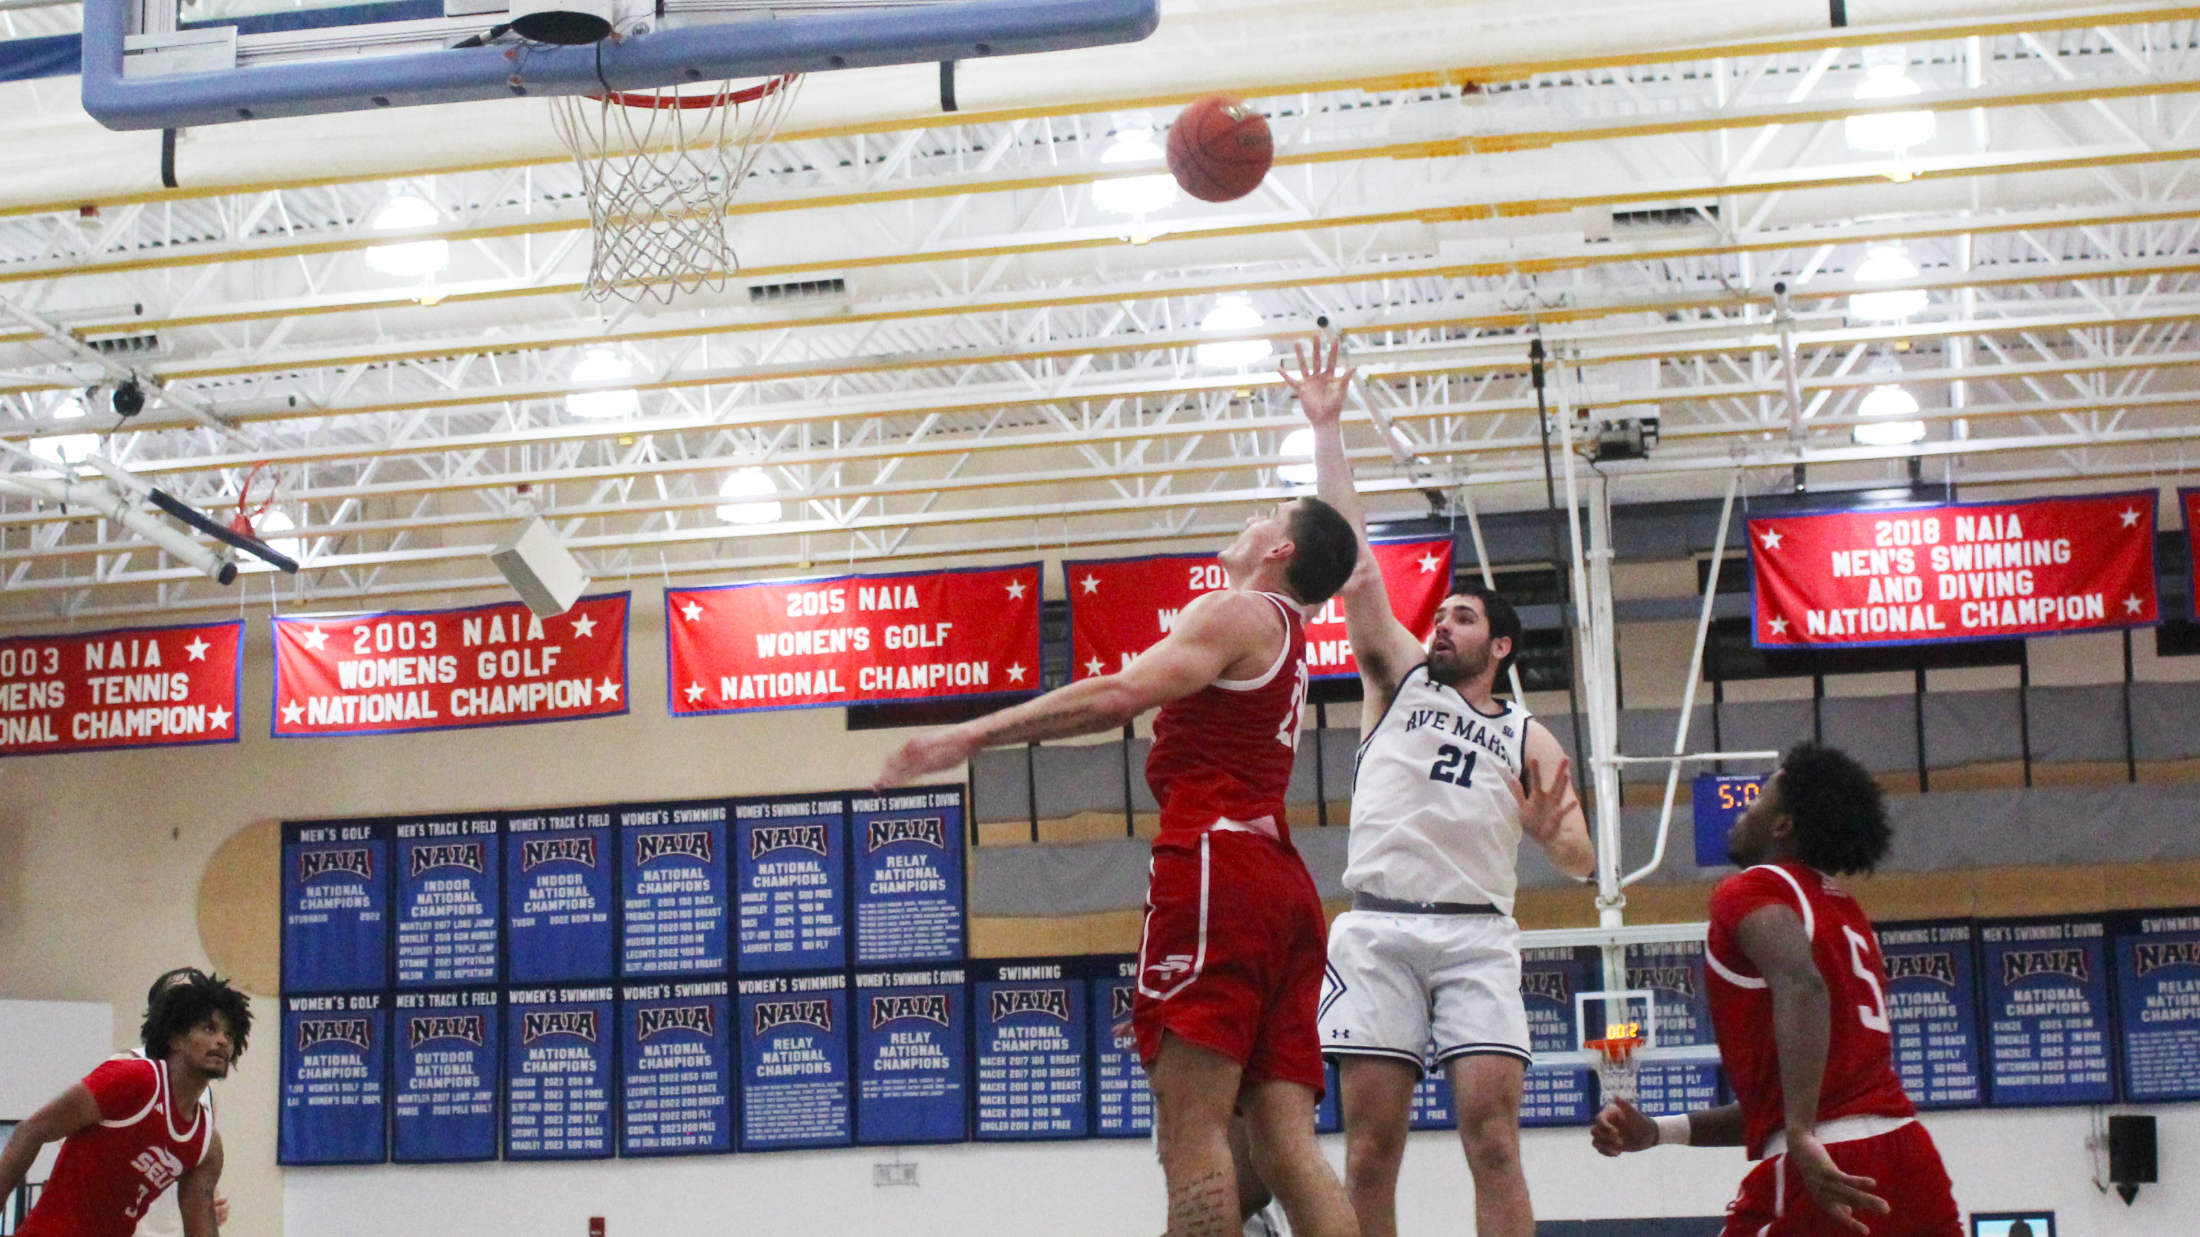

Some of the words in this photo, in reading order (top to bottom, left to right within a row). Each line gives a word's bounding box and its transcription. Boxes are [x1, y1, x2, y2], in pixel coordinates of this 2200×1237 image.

[1875, 518, 1940, 547] 2018
[1956, 514, 2023, 543] NAIA
[1832, 549, 1915, 578] MEN'S
[1931, 538, 2071, 573] SWIMMING
[1866, 577, 1923, 604] AND
[1939, 570, 2034, 601] DIVING
[786, 589, 845, 618] 2015
[858, 585, 919, 611] NAIA
[1807, 605, 1946, 636] NATIONAL
[1961, 594, 2105, 628] CHAMPION
[352, 621, 438, 655] 2003
[463, 614, 546, 647] NAIA
[756, 627, 870, 659] WOMEN'S
[884, 622, 953, 650] GOLF
[85, 639, 161, 671] NAIA
[337, 655, 457, 690] WOMENS
[477, 646, 562, 680] GOLF
[87, 672, 189, 705] TENNIS
[720, 668, 845, 702] NATIONAL
[859, 661, 989, 692] CHAMPION
[307, 692, 439, 726] NATIONAL
[450, 678, 593, 718] CHAMPION
[72, 704, 206, 740] CHAMPION
[1405, 709, 1450, 732] AVE
[1429, 743, 1477, 789] 21
[736, 804, 770, 819] WOMEN'S
[772, 802, 810, 817] SWIMMING
[818, 800, 843, 814] DIVING
[852, 797, 887, 813] WOMEN'S
[888, 795, 927, 810] SWIMMING
[935, 793, 960, 807] DIVING
[509, 816, 546, 832] WOMEN'S
[550, 815, 575, 830] TRACK
[587, 813, 610, 828] FIELD
[621, 810, 669, 826] WOMEN'S
[673, 807, 726, 823] SWIMMING
[300, 827, 337, 842] MEN'S
[341, 826, 371, 841] GOLF
[397, 823, 425, 838] MEN'S
[428, 822, 458, 836] TRACK
[471, 820, 497, 834] FIELD
[869, 817, 944, 853] NAIA
[637, 832, 711, 867] NAIA
[752, 825, 827, 860] NAIA
[411, 843, 483, 877] NAIA
[523, 837, 595, 873] NAIA
[886, 855, 927, 868] RELAY
[300, 848, 371, 882] NAIA
[758, 861, 821, 875] NATIONAL
[536, 874, 583, 887] INDOOR
[643, 868, 705, 882] NATIONAL
[752, 873, 828, 888] CHAMPIONS
[875, 867, 940, 881] NATIONAL
[306, 884, 366, 898] NATIONAL
[423, 879, 471, 892] INDOOR
[529, 886, 590, 900] NATIONAL
[637, 880, 710, 894] CHAMPIONS
[869, 879, 946, 894] CHAMPIONS
[300, 896, 371, 910] CHAMPIONS
[417, 892, 478, 905] NATIONAL
[523, 898, 595, 913] CHAMPIONS
[411, 904, 483, 917] CHAMPIONS
[998, 965, 1061, 980] SWIMMING
[2003, 949, 2089, 986] NAIA
[738, 979, 787, 994] WOMEN'S
[791, 975, 846, 991] SWIMMING
[855, 972, 891, 987] WOMEN'S
[892, 971, 931, 986] SWIMMING
[940, 970, 965, 984] DIVING
[1842, 924, 1890, 1033] 5
[509, 989, 557, 1004] WOMEN'S
[560, 986, 613, 1002] SWIMMING
[622, 985, 671, 1001] WOMEN'S
[674, 982, 728, 998] SWIMMING
[2013, 988, 2084, 1002] NATIONAL
[289, 996, 345, 1011] WOMEN'S
[350, 995, 380, 1009] GOLF
[396, 993, 425, 1008] MEN'S
[428, 993, 458, 1007] TRACK
[472, 992, 497, 1006] FIELD
[992, 989, 1069, 1023] NAIA
[873, 994, 949, 1030] NAIA
[2006, 1001, 2090, 1016] CHAMPIONS
[638, 1005, 713, 1042] NAIA
[755, 1000, 831, 1036] NAIA
[299, 1019, 369, 1052] NAIA
[411, 1015, 482, 1050] NAIA
[523, 1011, 596, 1045] NAIA
[998, 1026, 1062, 1039] NATIONAL
[773, 1037, 813, 1050] RELAY
[890, 1031, 931, 1044] RELAY
[992, 1039, 1069, 1052] CHAMPIONS
[415, 1051, 474, 1064] OUTDOOR
[529, 1047, 591, 1060] NATIONAL
[644, 1043, 706, 1057] NATIONAL
[762, 1049, 825, 1064] NATIONAL
[880, 1044, 943, 1058] NATIONAL
[304, 1054, 363, 1067] NATIONAL
[522, 1060, 597, 1073] CHAMPIONS
[638, 1055, 712, 1070] CHAMPIONS
[873, 1057, 950, 1071] CHAMPIONS
[980, 1056, 1007, 1066] MACEK
[298, 1066, 368, 1080] CHAMPIONS
[415, 1064, 475, 1077] NATIONAL
[756, 1062, 832, 1077] CHAMPIONS
[980, 1069, 1007, 1079] MACEK
[409, 1076, 480, 1090] CHAMPIONS
